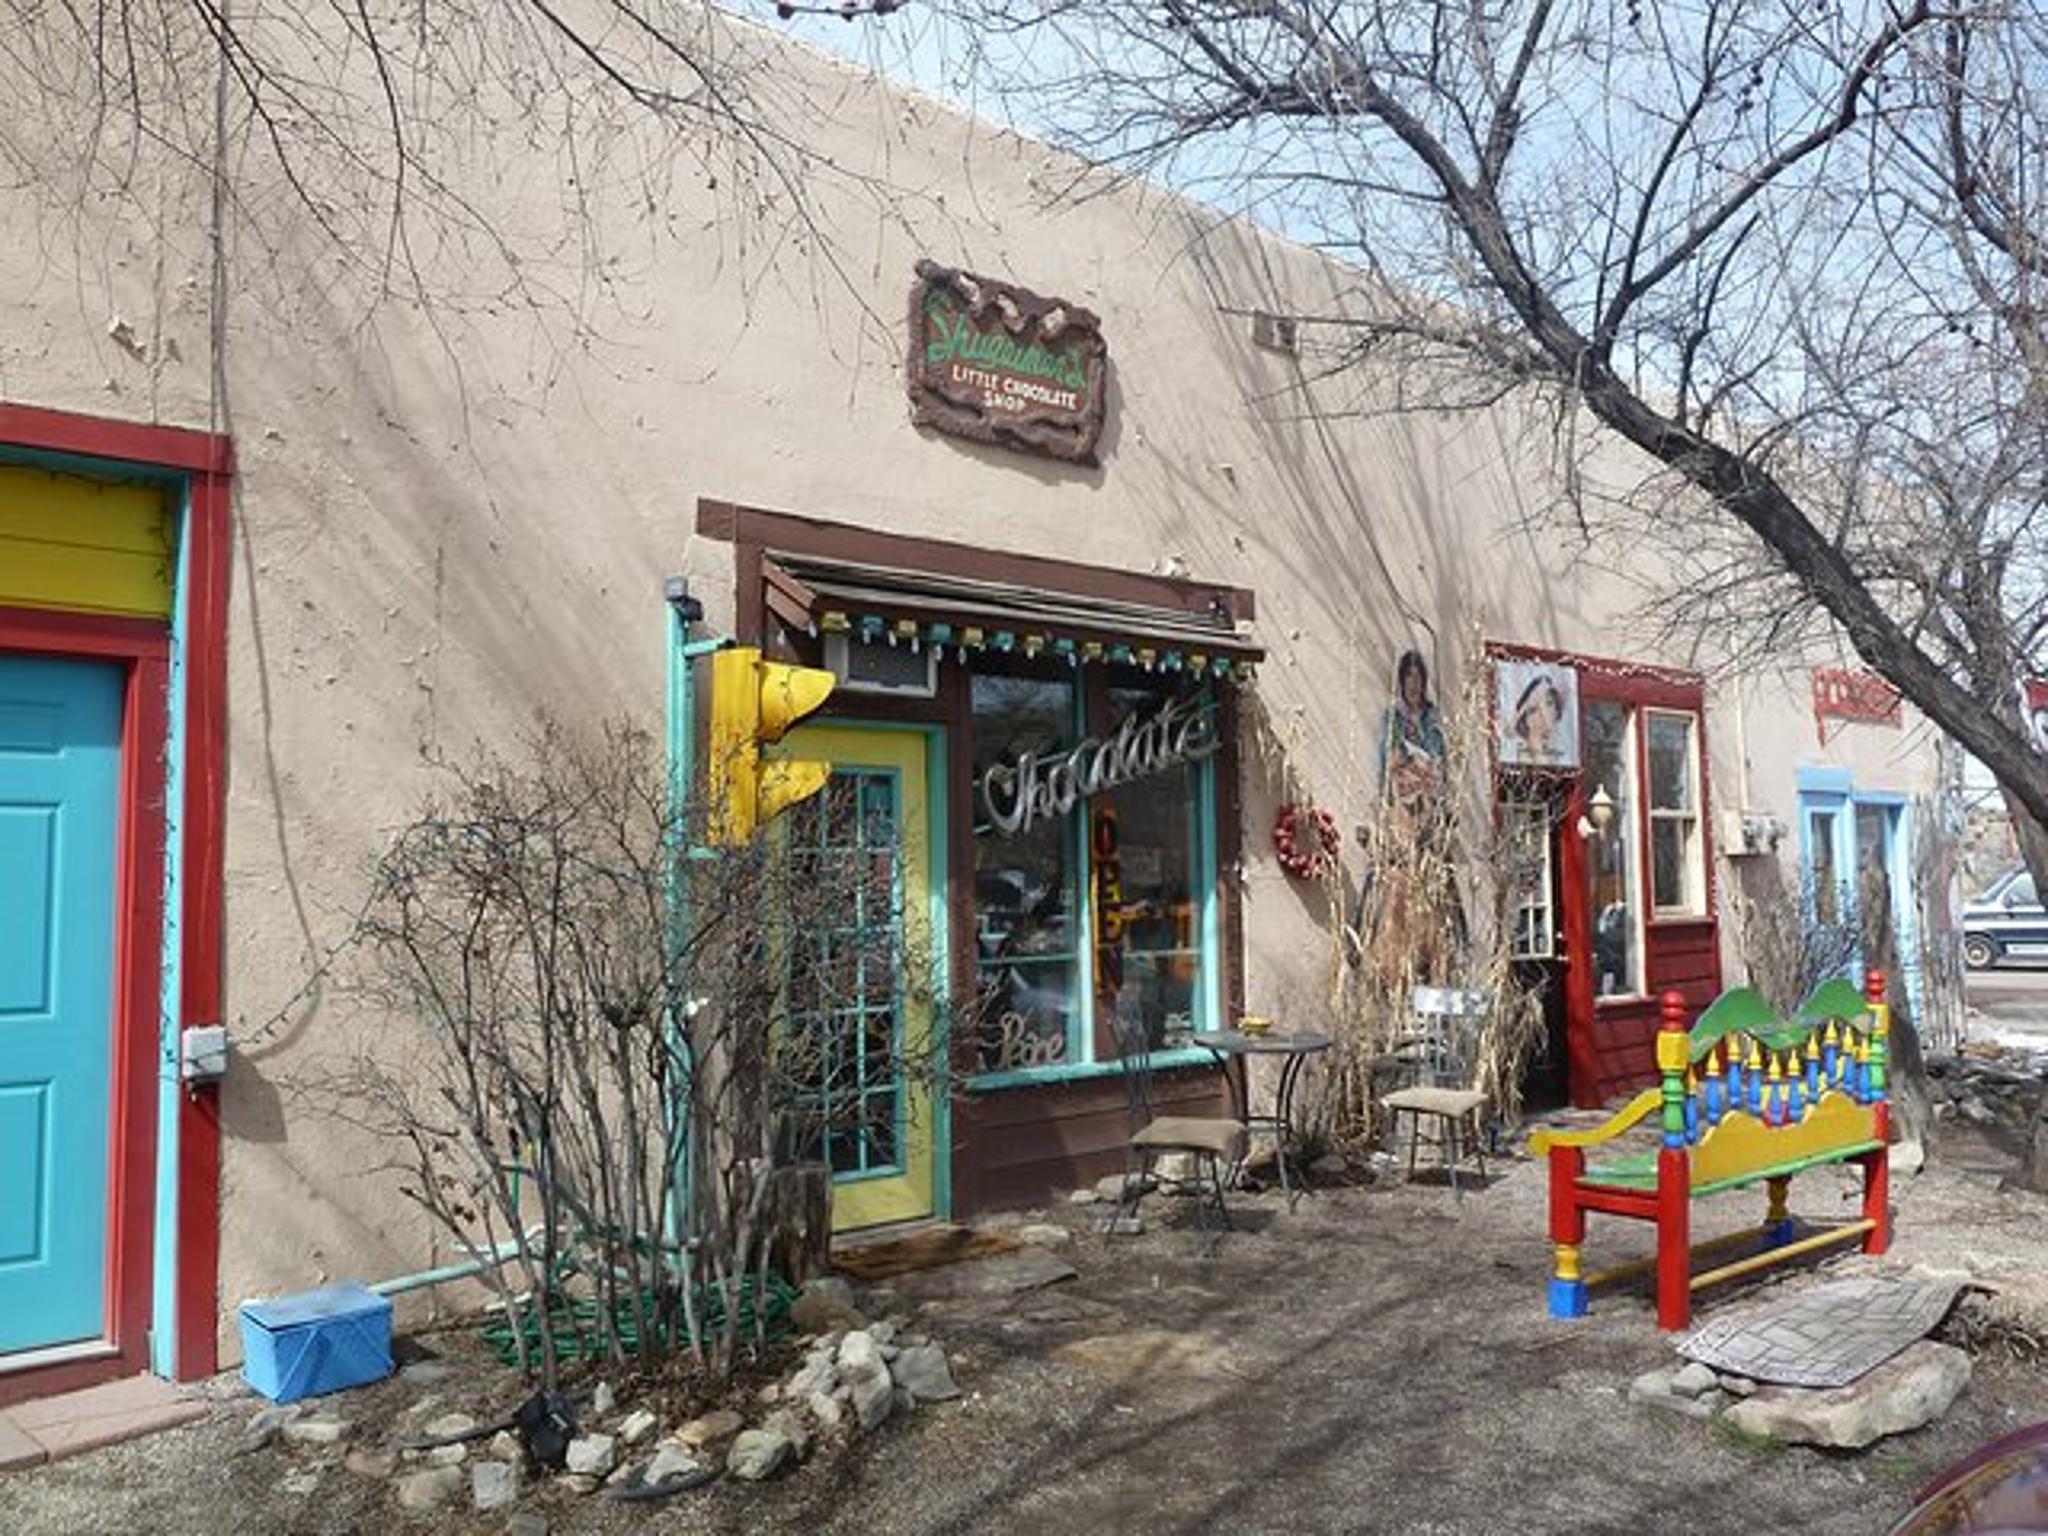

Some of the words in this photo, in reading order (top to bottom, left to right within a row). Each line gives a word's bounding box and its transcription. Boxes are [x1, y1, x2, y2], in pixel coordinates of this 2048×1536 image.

[952, 365, 999, 389] LITTLE
[1003, 377, 1077, 410] CHOCOLATE
[984, 391, 1026, 411] SHOP
[984, 689, 1222, 834] Chocolate
[1093, 815, 1123, 990] OPEN
